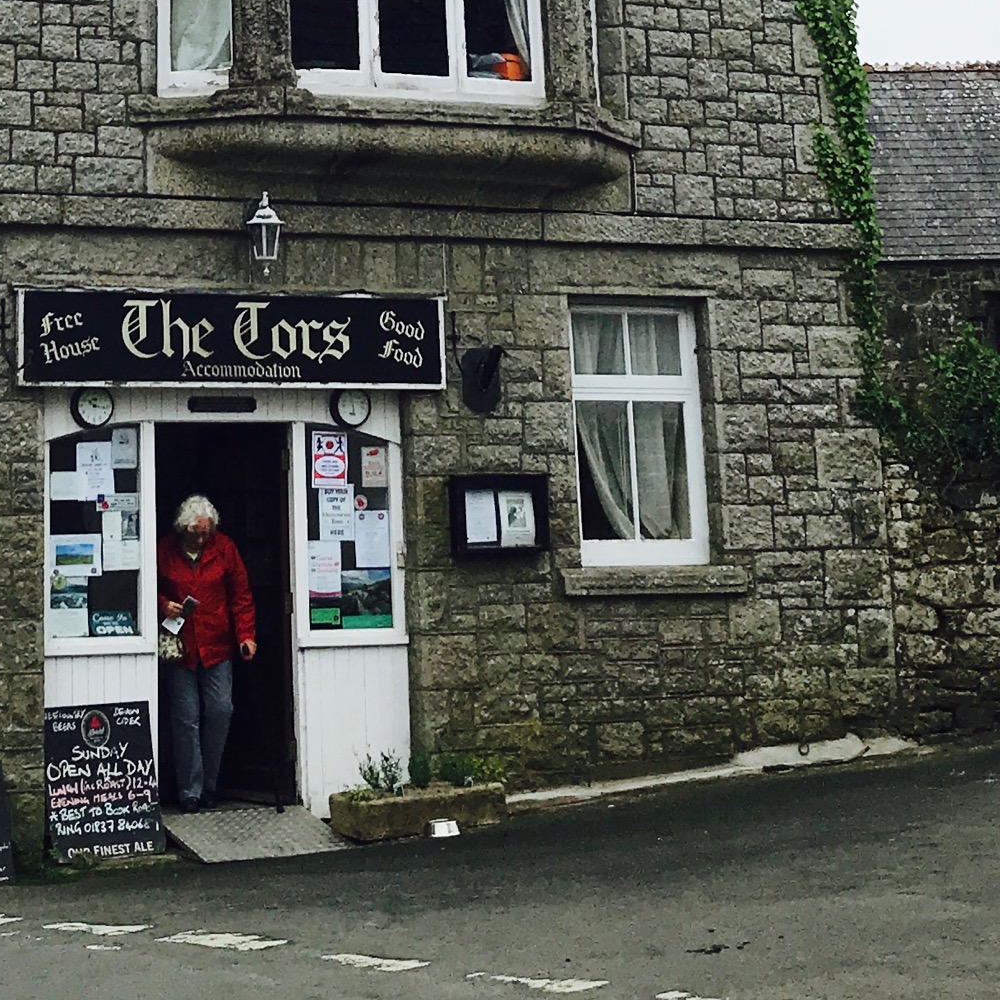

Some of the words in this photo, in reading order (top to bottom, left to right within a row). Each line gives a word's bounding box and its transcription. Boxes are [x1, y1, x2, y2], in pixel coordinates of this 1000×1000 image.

[40, 311, 83, 337] Free
[121, 298, 215, 360] The
[233, 301, 352, 364] Tors
[379, 310, 425, 341] Good
[40, 336, 100, 364] House
[378, 339, 423, 368] Food
[181, 360, 302, 379] Accommodation
[95, 625, 134, 635] OPEN
[72, 742, 128, 760] SUNDAY
[46, 759, 91, 781] OPEN
[97, 762, 123, 777] ALL
[123, 758, 153, 775] DAY
[93, 791, 123, 803] MEALS
[88, 806, 103, 817] TO
[104, 802, 131, 816] BOOK
[55, 821, 83, 836] RING
[84, 819, 115, 834] 01837
[93, 843, 131, 856] FINEST
[134, 840, 155, 852] ALE
